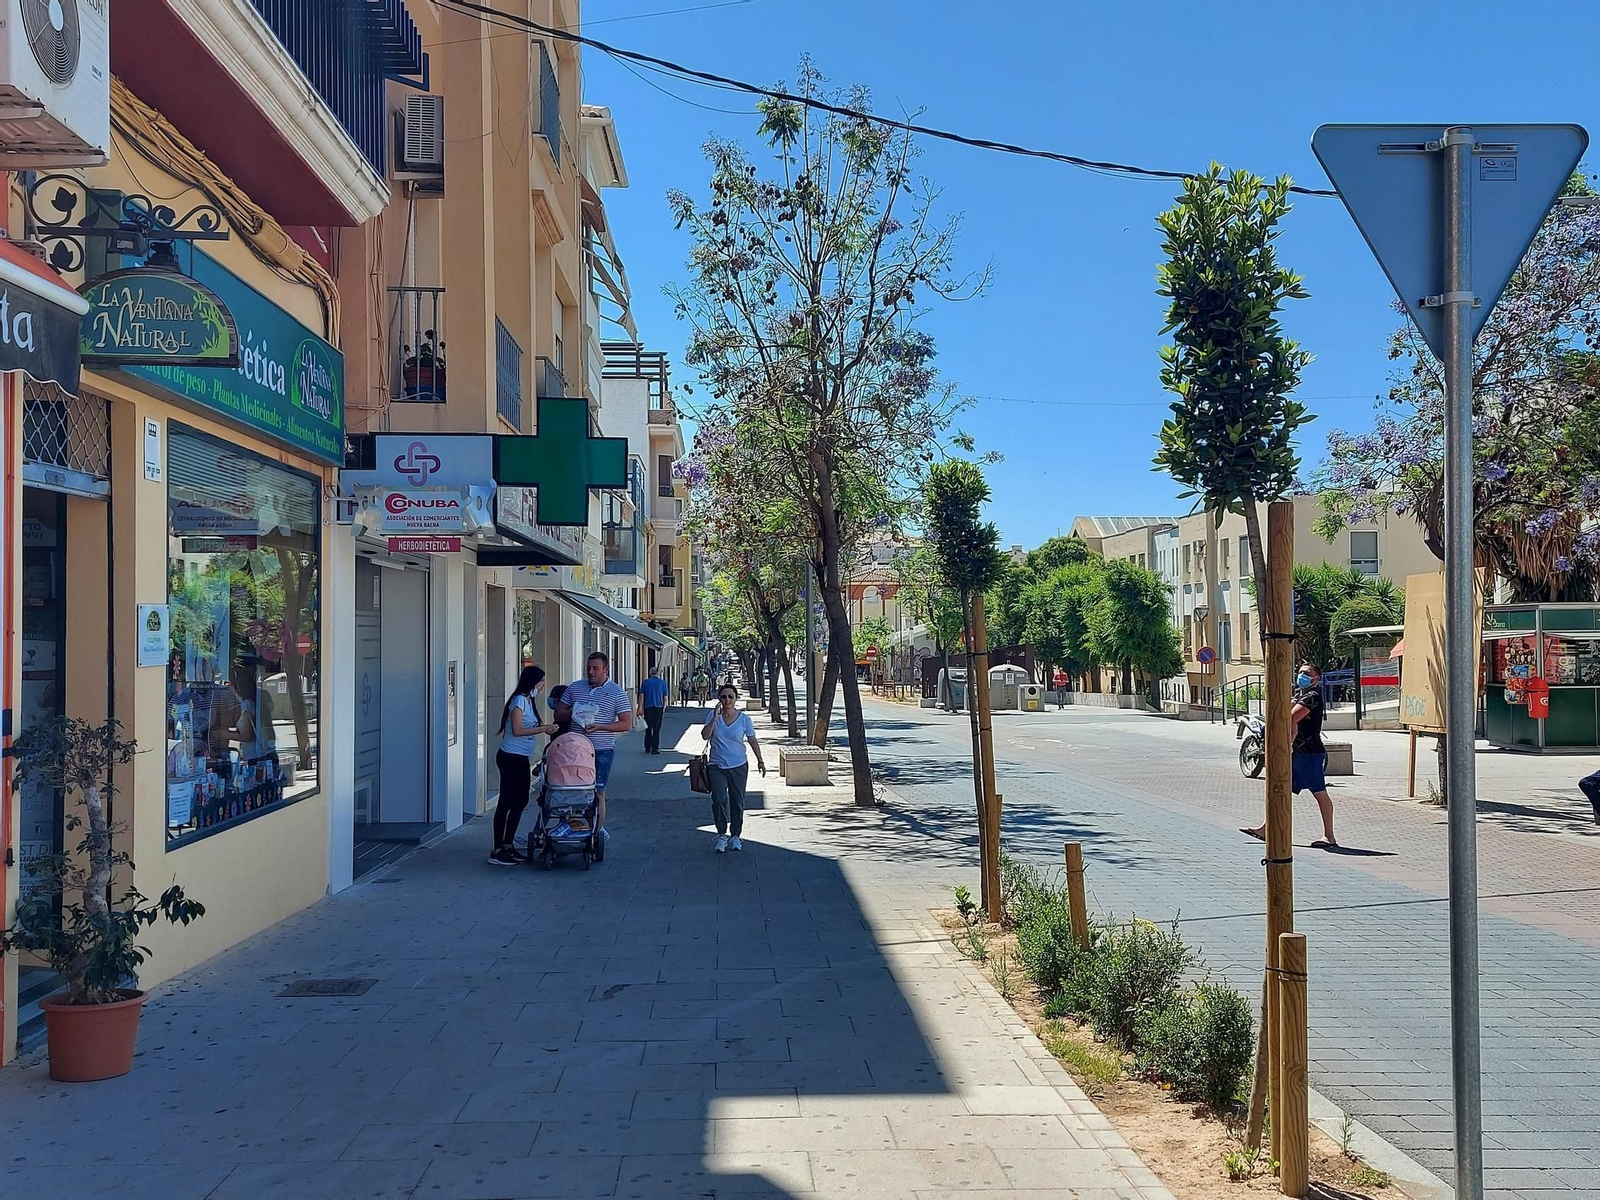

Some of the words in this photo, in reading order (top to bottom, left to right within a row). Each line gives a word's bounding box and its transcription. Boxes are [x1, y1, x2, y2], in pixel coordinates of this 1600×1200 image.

[121, 287, 194, 322] VENTANA
[93, 308, 192, 354] NATURAL
[233, 330, 286, 396] tética
[173, 366, 185, 385] de
[185, 373, 206, 395] peso
[213, 378, 240, 411] Plantas
[240, 394, 282, 429] Medicinales
[286, 414, 315, 444] Alimentos
[315, 428, 340, 455] Naturales
[385, 493, 460, 514] CONUBA
